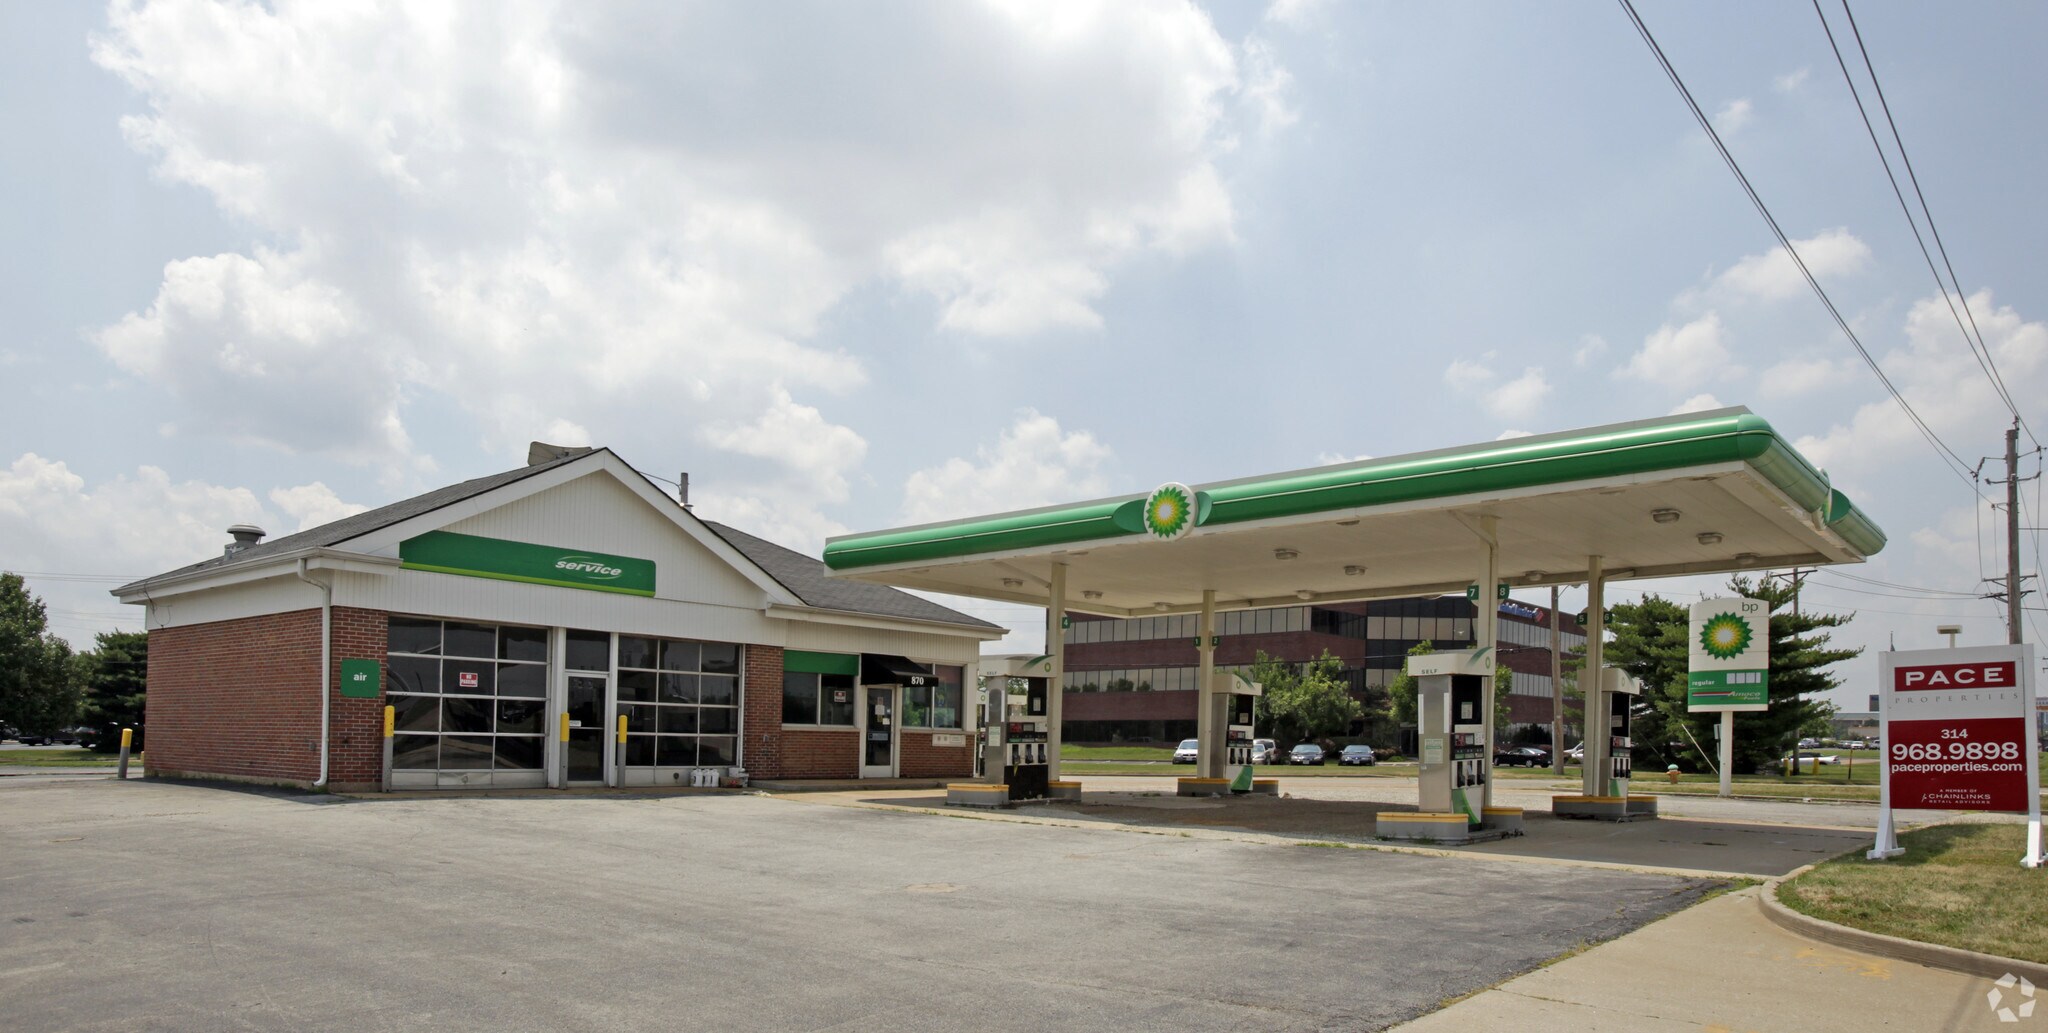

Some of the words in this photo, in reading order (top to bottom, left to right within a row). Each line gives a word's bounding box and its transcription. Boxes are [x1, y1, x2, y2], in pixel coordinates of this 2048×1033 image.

[555, 560, 622, 576] service
[1469, 588, 1476, 597] 7
[1499, 587, 1506, 596] 8
[1741, 602, 1759, 613] bp
[1063, 618, 1069, 626] 4
[1578, 614, 1585, 622] 5
[353, 672, 367, 682] air
[911, 676, 924, 685] 870
[1905, 667, 2004, 686] PACE
[1895, 692, 2018, 704] PROPERTIES
[1941, 728, 1968, 739] 314
[1892, 742, 2019, 761] 968.9898
[1891, 761, 2023, 774] paceproperties.com
